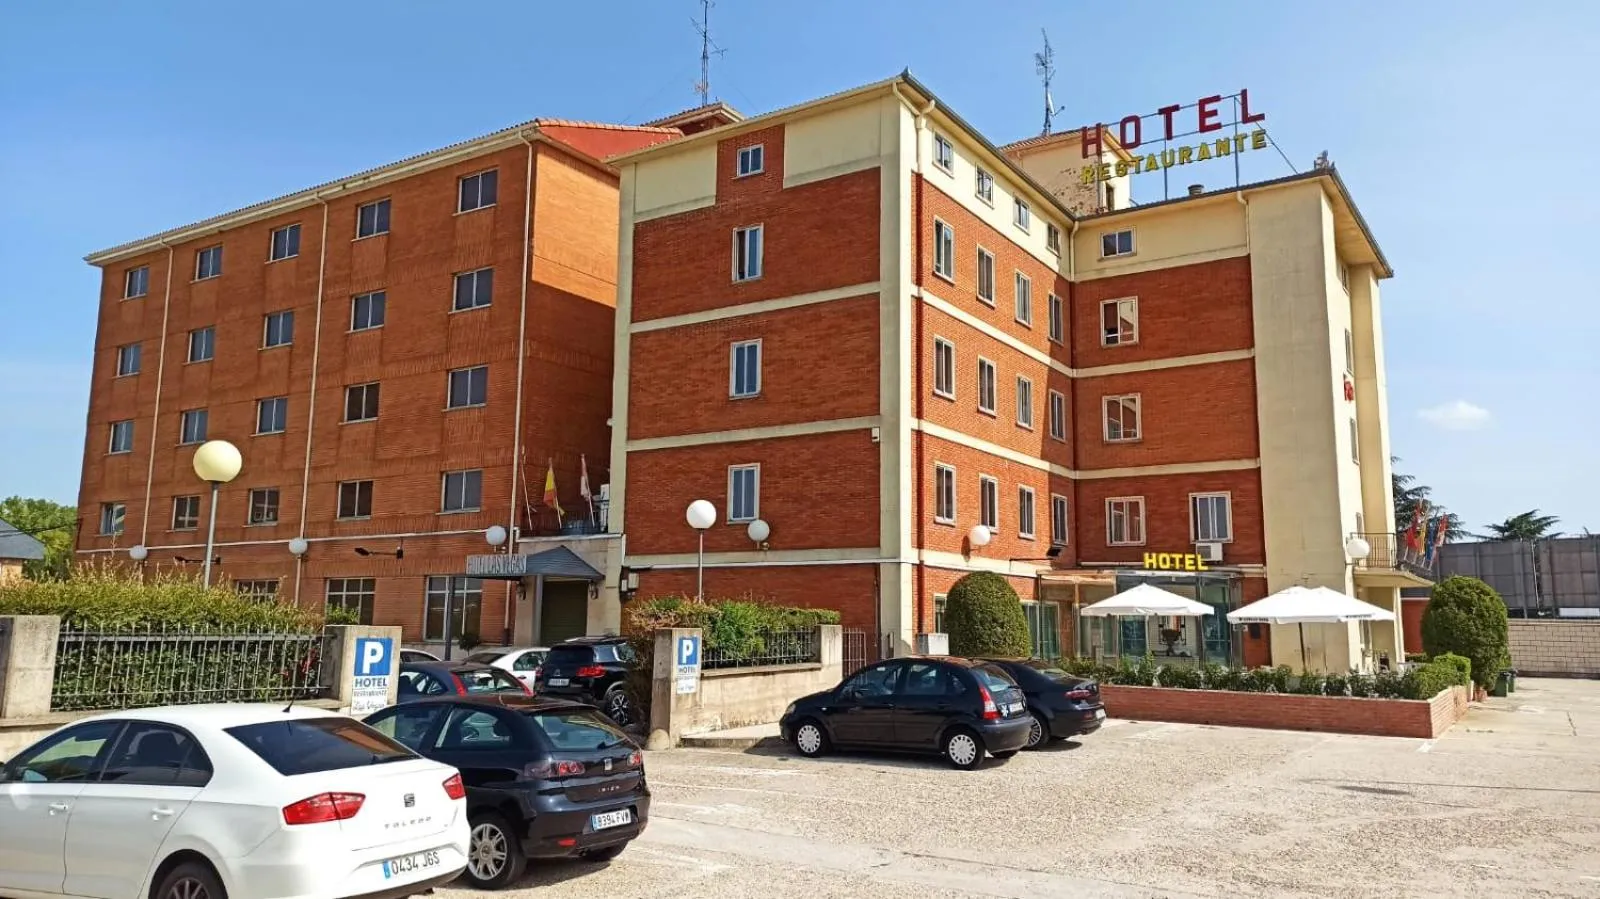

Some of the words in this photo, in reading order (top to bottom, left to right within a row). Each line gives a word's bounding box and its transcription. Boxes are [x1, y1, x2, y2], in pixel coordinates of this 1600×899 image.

[1081, 88, 1265, 159] HOTEL
[1079, 129, 1267, 184] RESTAURANTE
[1143, 552, 1209, 571] HOTEL
[362, 641, 384, 674] P
[682, 639, 694, 665] P
[354, 677, 388, 688] HOTEL
[384, 815, 432, 830] TOLEDO
[597, 813, 616, 828] 8394
[391, 855, 419, 875] 0434
[422, 851, 441, 867] JGS
